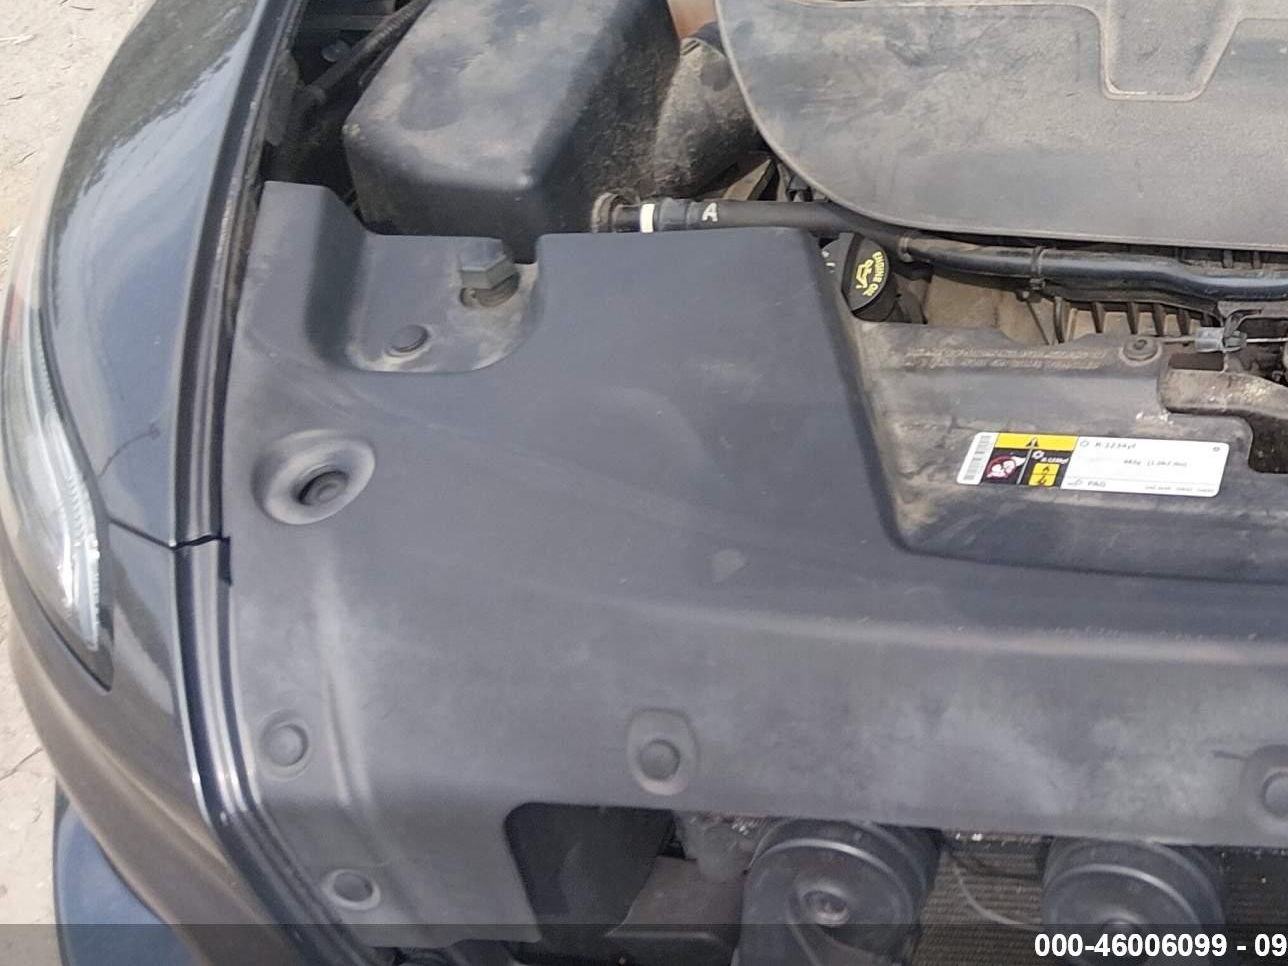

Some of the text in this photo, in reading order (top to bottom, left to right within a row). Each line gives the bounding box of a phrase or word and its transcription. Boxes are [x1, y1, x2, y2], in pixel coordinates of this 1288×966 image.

[701, 202, 719, 222] A
[862, 251, 886, 297] ENGINE OIL
